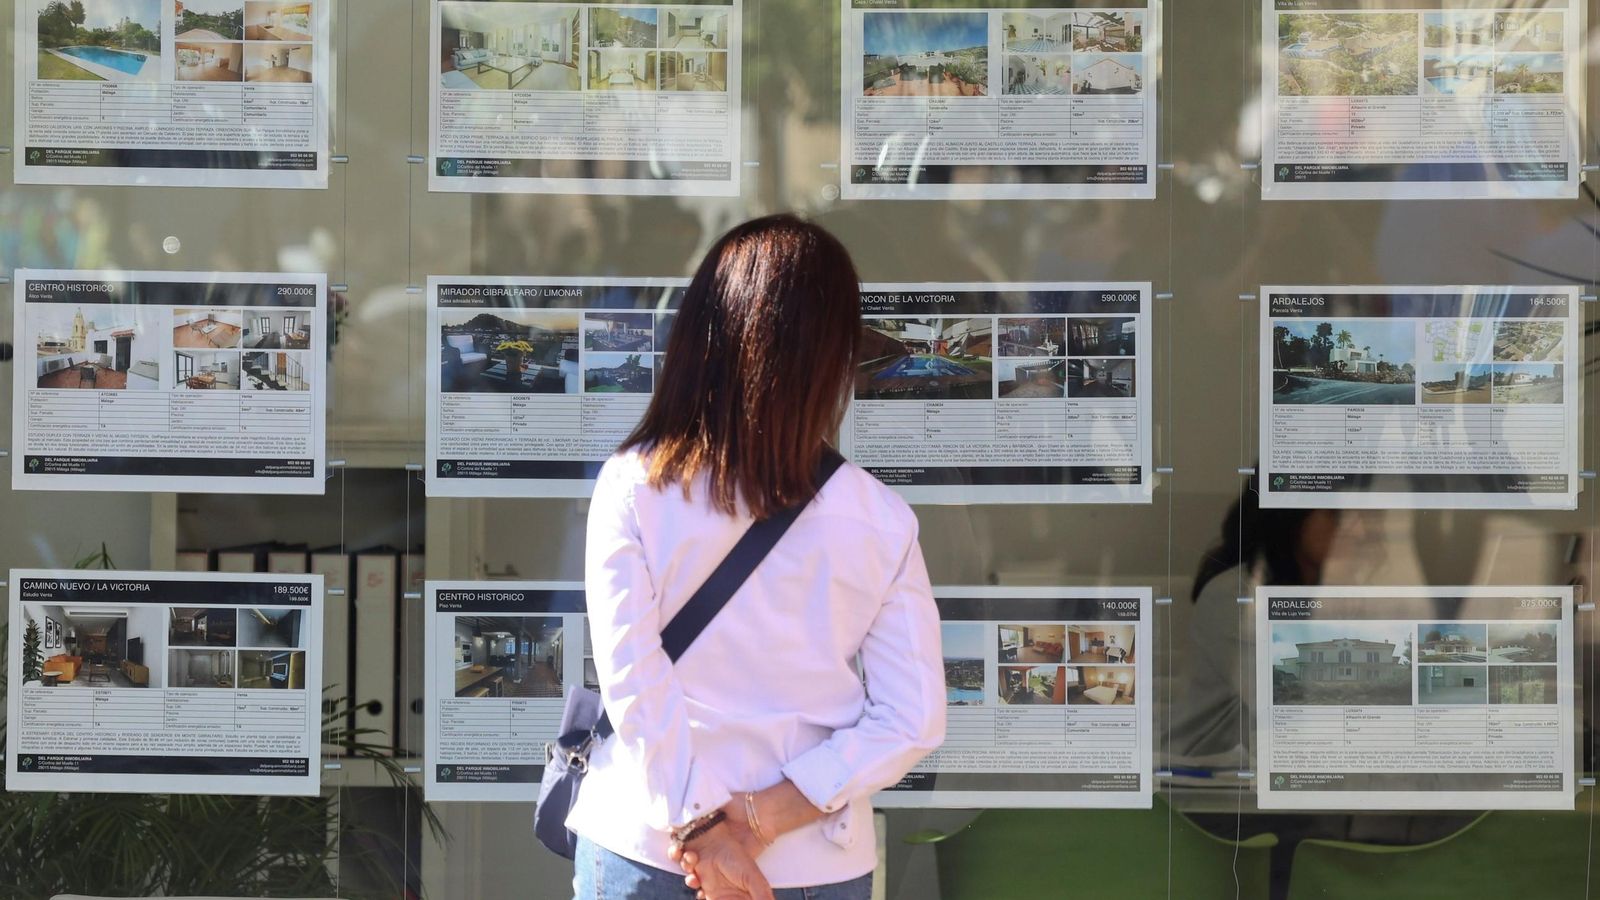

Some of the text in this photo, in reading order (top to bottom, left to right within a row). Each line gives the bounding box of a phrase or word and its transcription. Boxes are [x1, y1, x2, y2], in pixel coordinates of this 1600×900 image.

[29, 284, 114, 292] CENTRO HISTORICO
[1521, 600, 1558, 608] 875.000€
